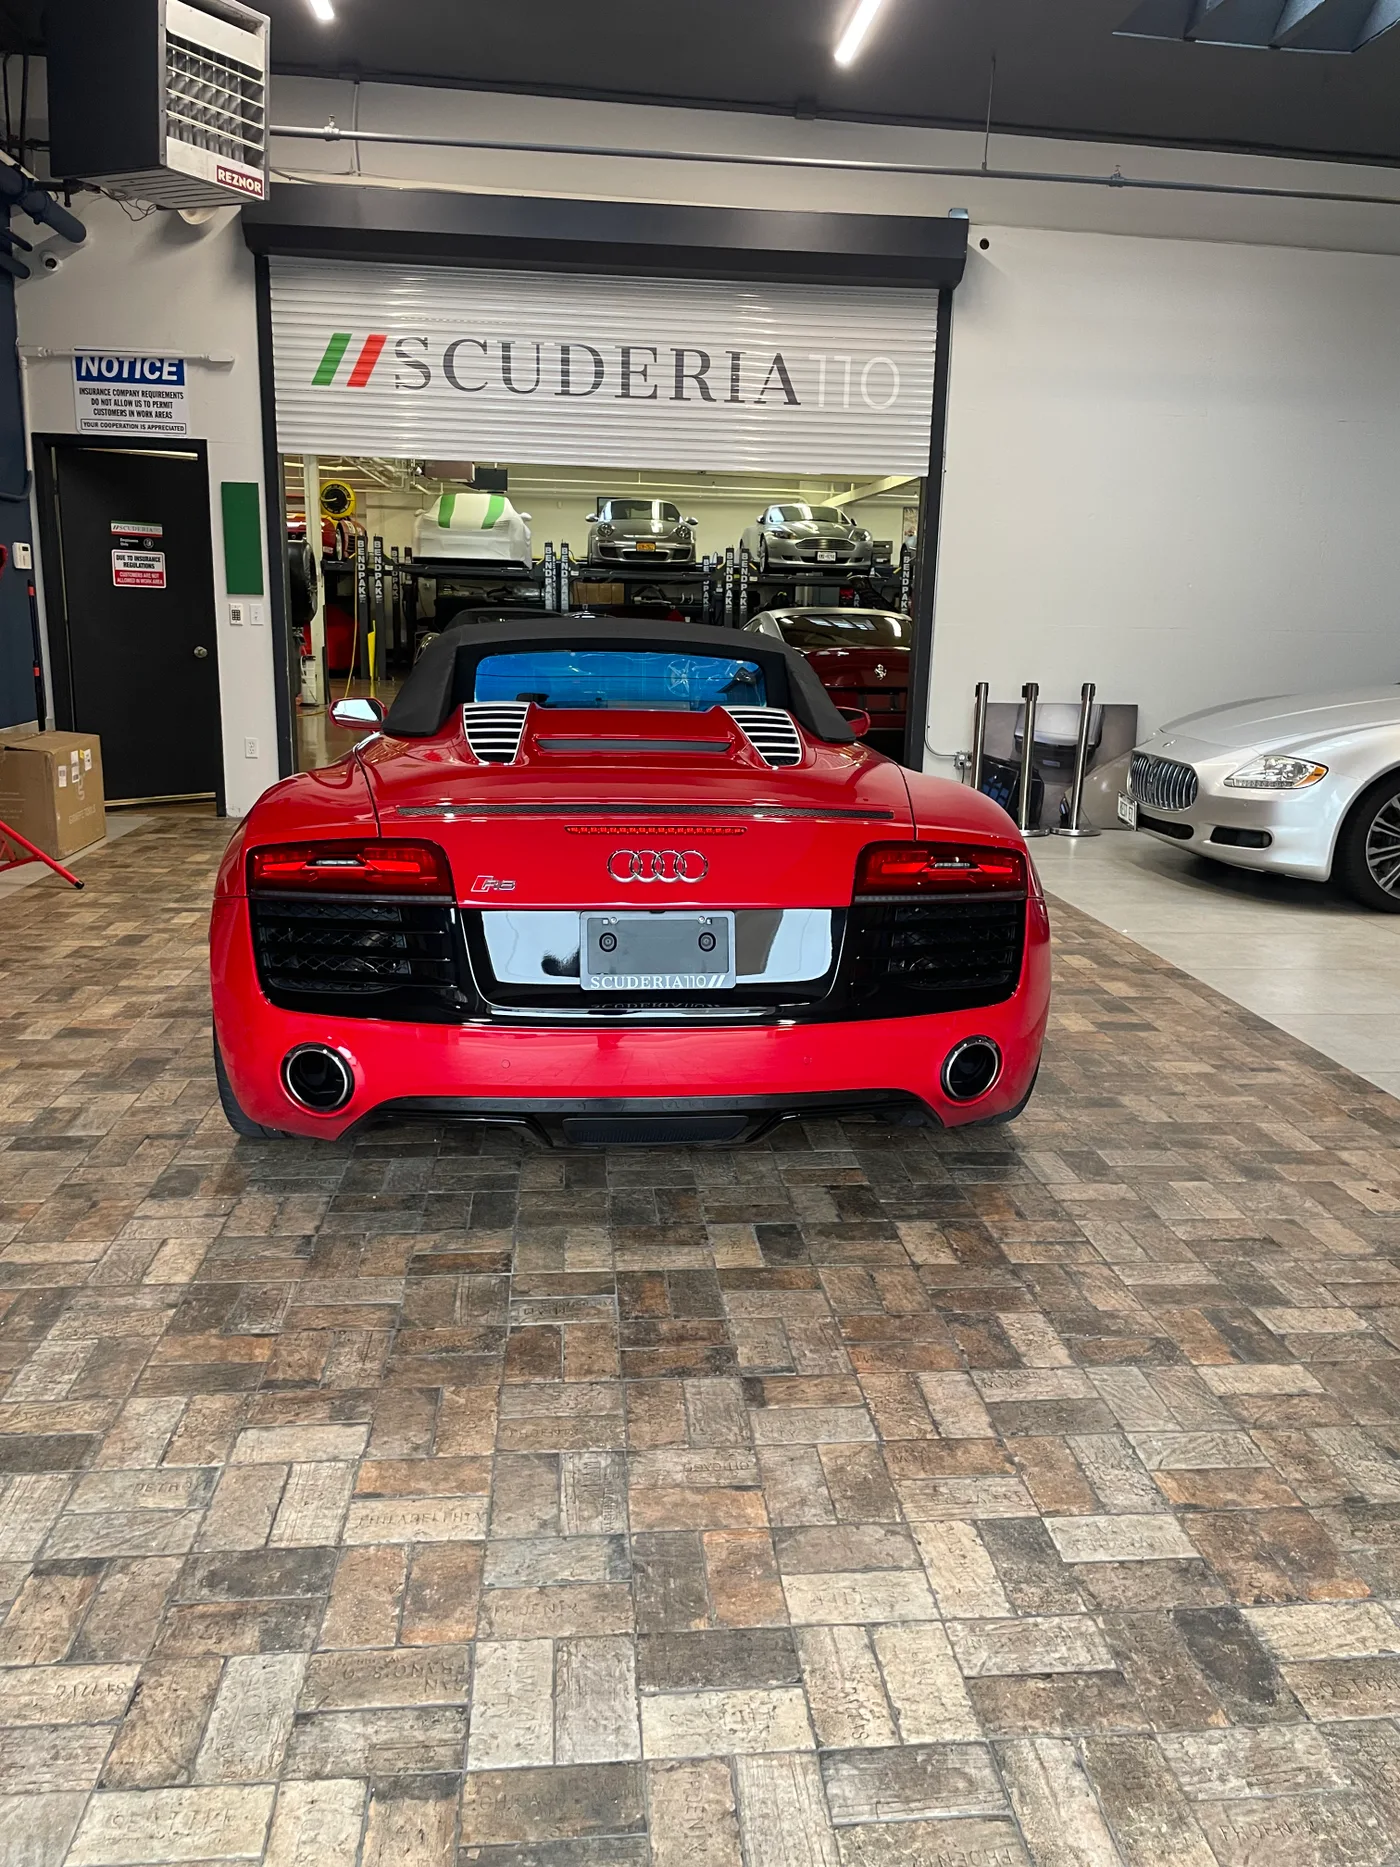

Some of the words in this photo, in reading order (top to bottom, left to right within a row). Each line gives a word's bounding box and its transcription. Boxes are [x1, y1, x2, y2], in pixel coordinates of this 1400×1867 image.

[217, 168, 262, 194] REZNOR
[80, 356, 179, 381] NOTICE
[79, 387, 111, 397] INSURANCE
[112, 388, 140, 398] COMPANY
[141, 390, 184, 400] REQUIREMENTS
[91, 398, 99, 406] DO
[101, 399, 112, 407] NOT
[114, 399, 133, 407] ALLOW
[135, 400, 142, 408] US
[143, 400, 151, 408] TO
[152, 401, 173, 409] PERMIT
[93, 408, 127, 417] CUSTOMERS
[128, 409, 135, 417] IN
[136, 410, 153, 418] WORK
[154, 411, 173, 419] AREAS
[100, 422, 139, 430] COOPERATION
[147, 424, 185, 432] APPRECIATED
[357, 540, 367, 594] BENDPAK
[373, 541, 383, 594] BENDPAK
[391, 550, 399, 597] BEDPAK
[545, 546, 553, 601] BENDPAK
[561, 547, 569, 601] BENDPAK
[725, 552, 733, 605] BENDPAK
[740, 552, 749, 605] BENDPAK
[901, 556, 910, 608] BENDPAK
